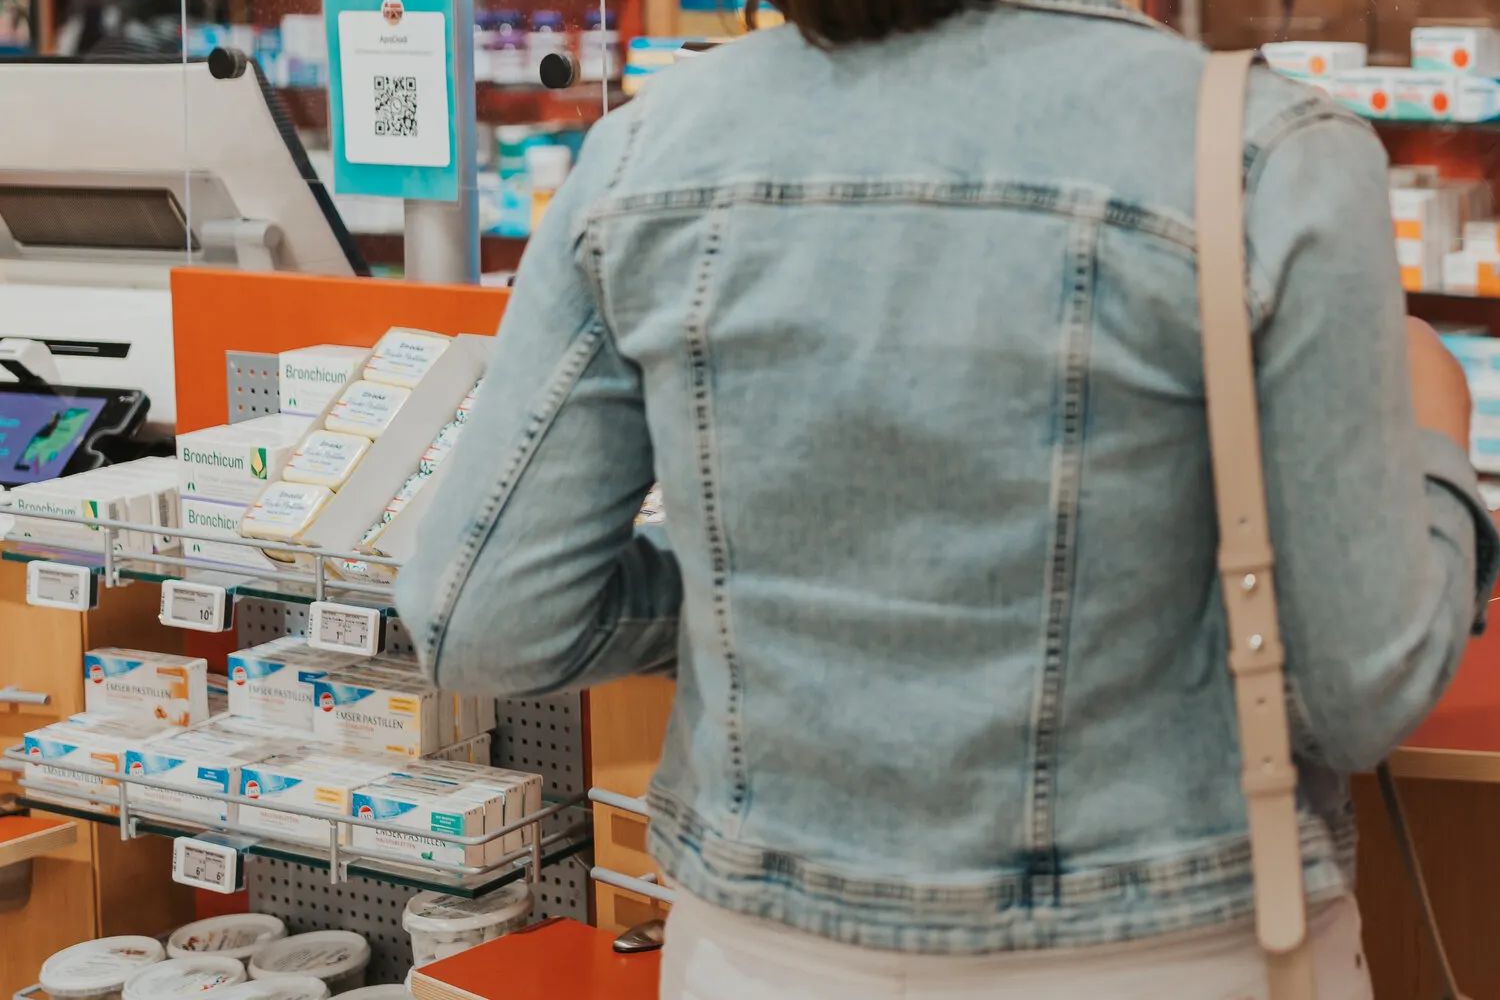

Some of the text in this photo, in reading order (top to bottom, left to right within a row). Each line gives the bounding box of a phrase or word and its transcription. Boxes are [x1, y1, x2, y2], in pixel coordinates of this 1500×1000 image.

[285, 364, 348, 384] Bronchicum
[183, 447, 245, 470] Bronchicum
[106, 682, 131, 694] EMSER
[132, 685, 172, 699] PASTILLEN
[248, 685, 313, 702] EMSER PASTILLEN
[336, 711, 404, 730] EMSER PASTILLEN
